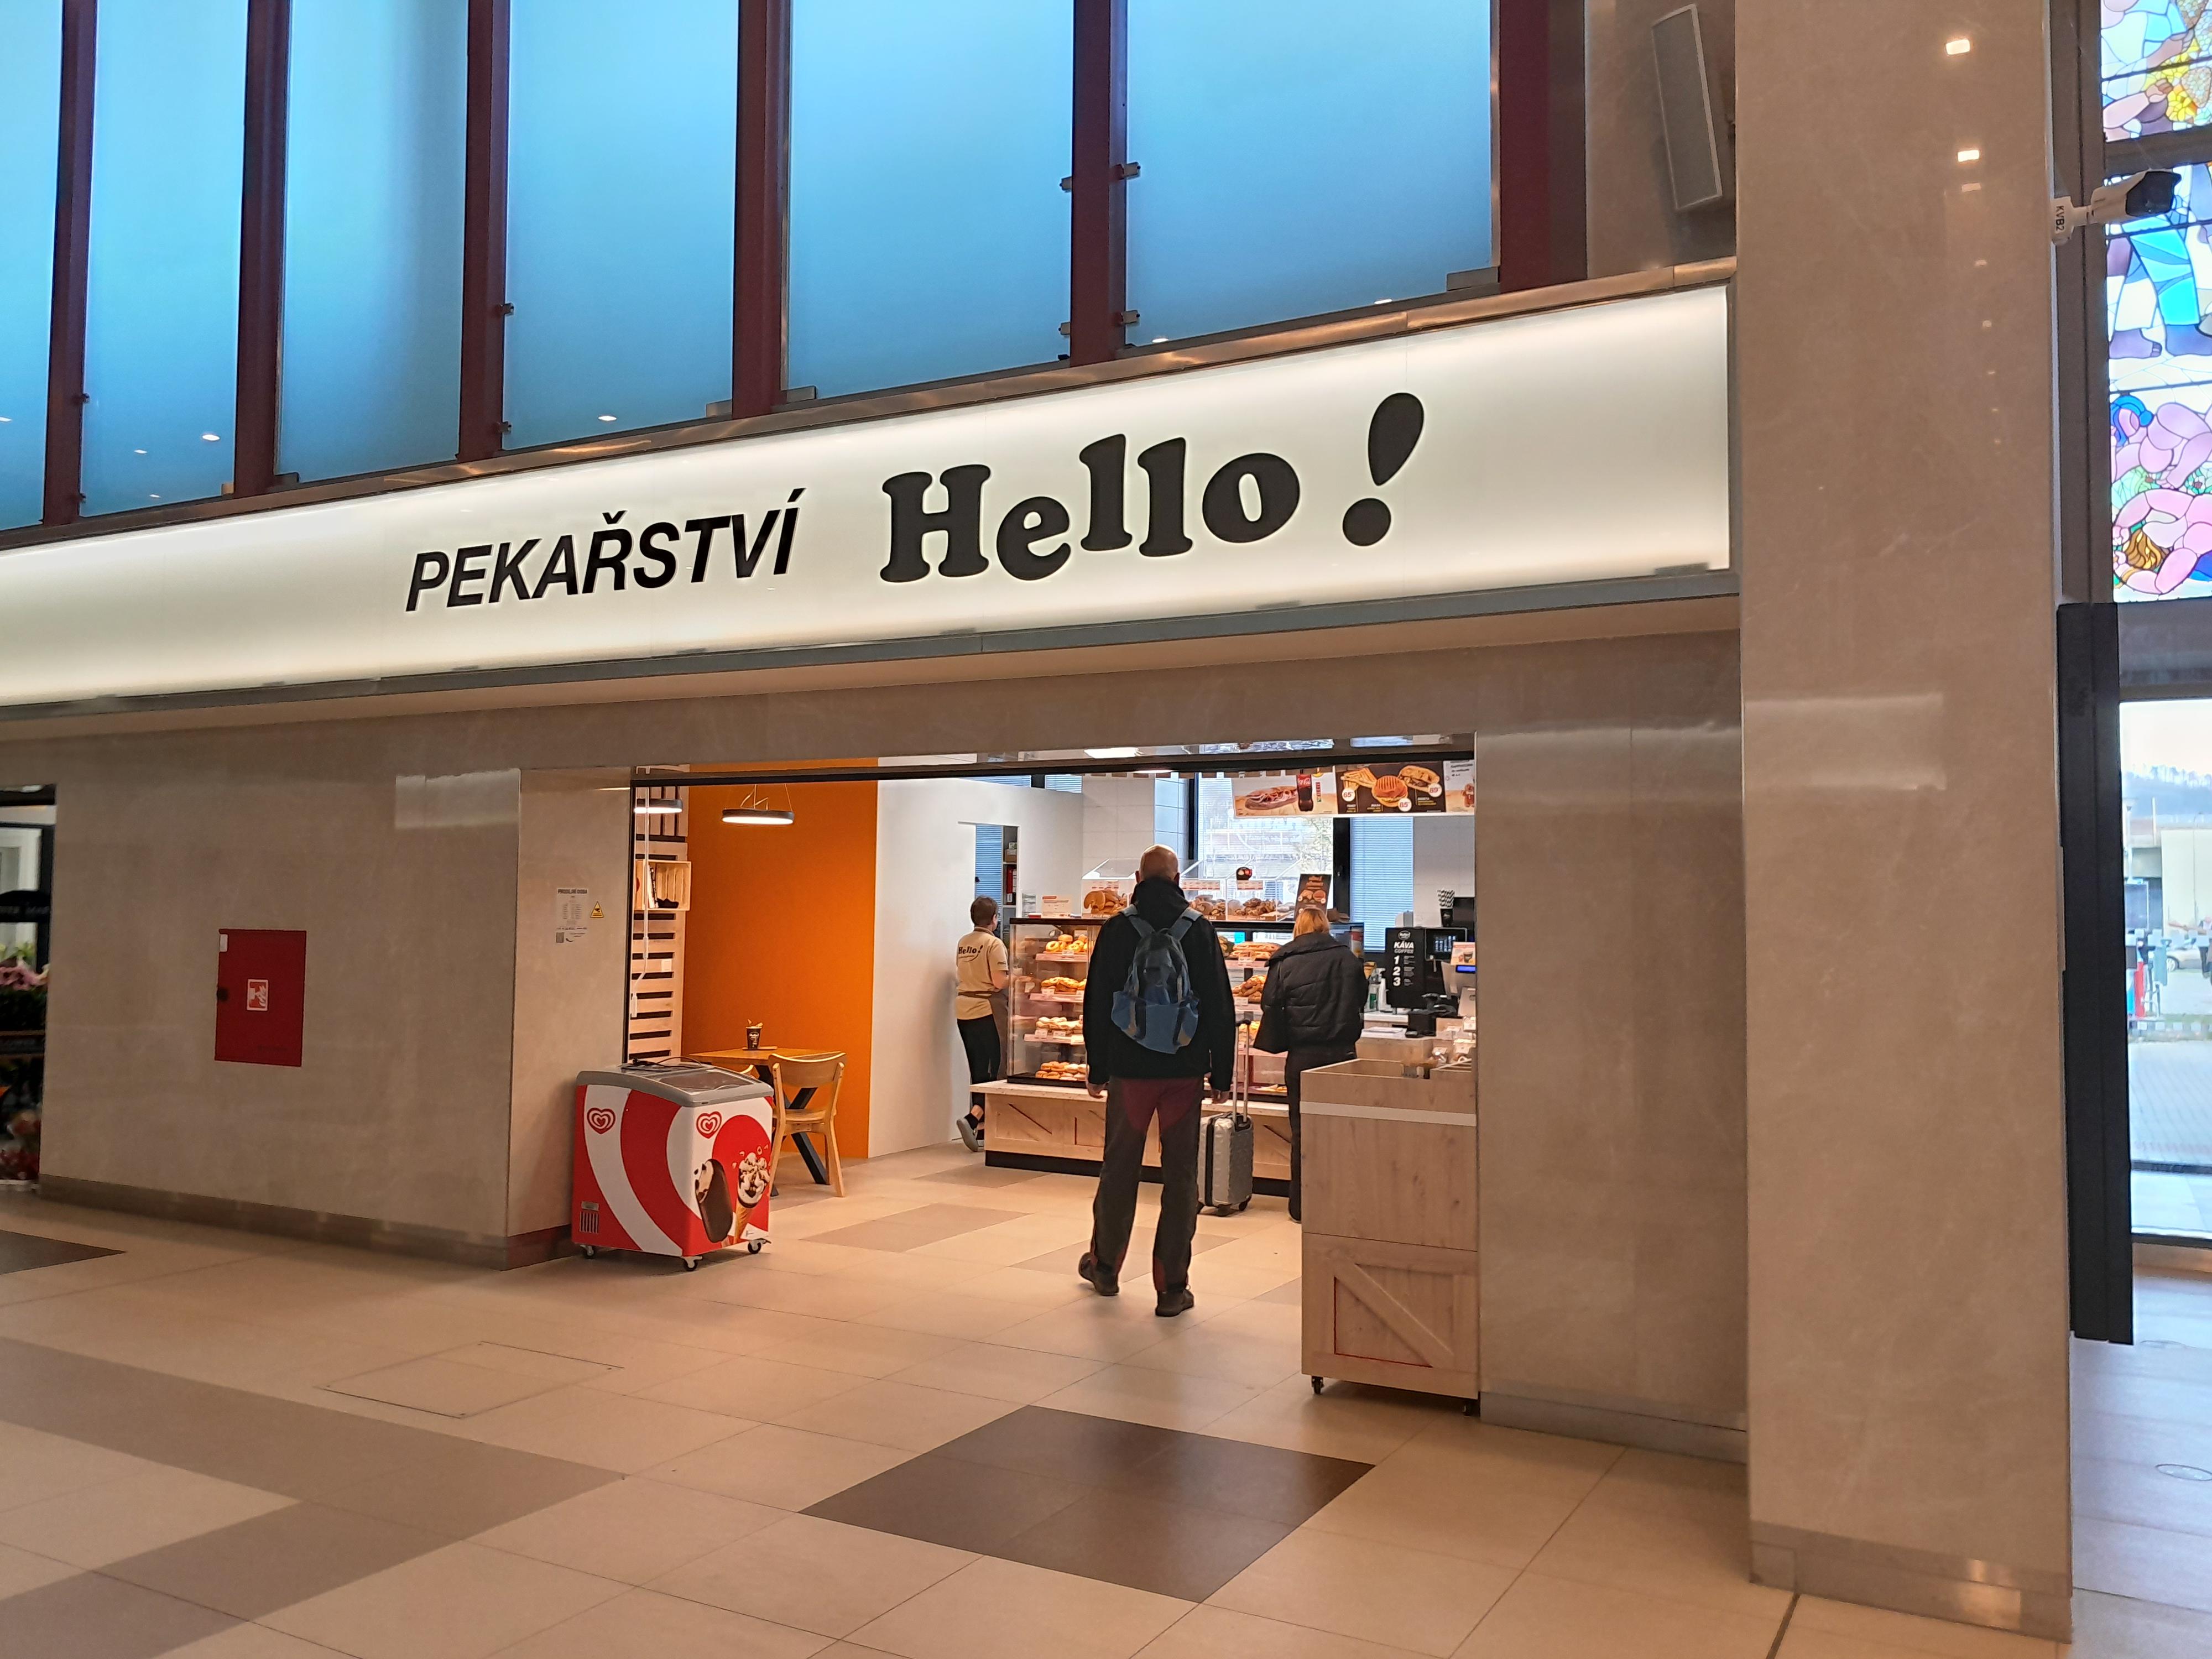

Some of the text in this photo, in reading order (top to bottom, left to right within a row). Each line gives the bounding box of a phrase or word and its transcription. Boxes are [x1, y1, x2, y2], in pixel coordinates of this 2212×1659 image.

[2056, 205, 2064, 231] KVB2
[405, 487, 806, 612] PEKAŘSTVÍ
[1393, 940, 1415, 949] KÁVA
[1394, 955, 1400, 965] 1
[1392, 966, 1401, 976] 2
[1392, 977, 1401, 986] 3
